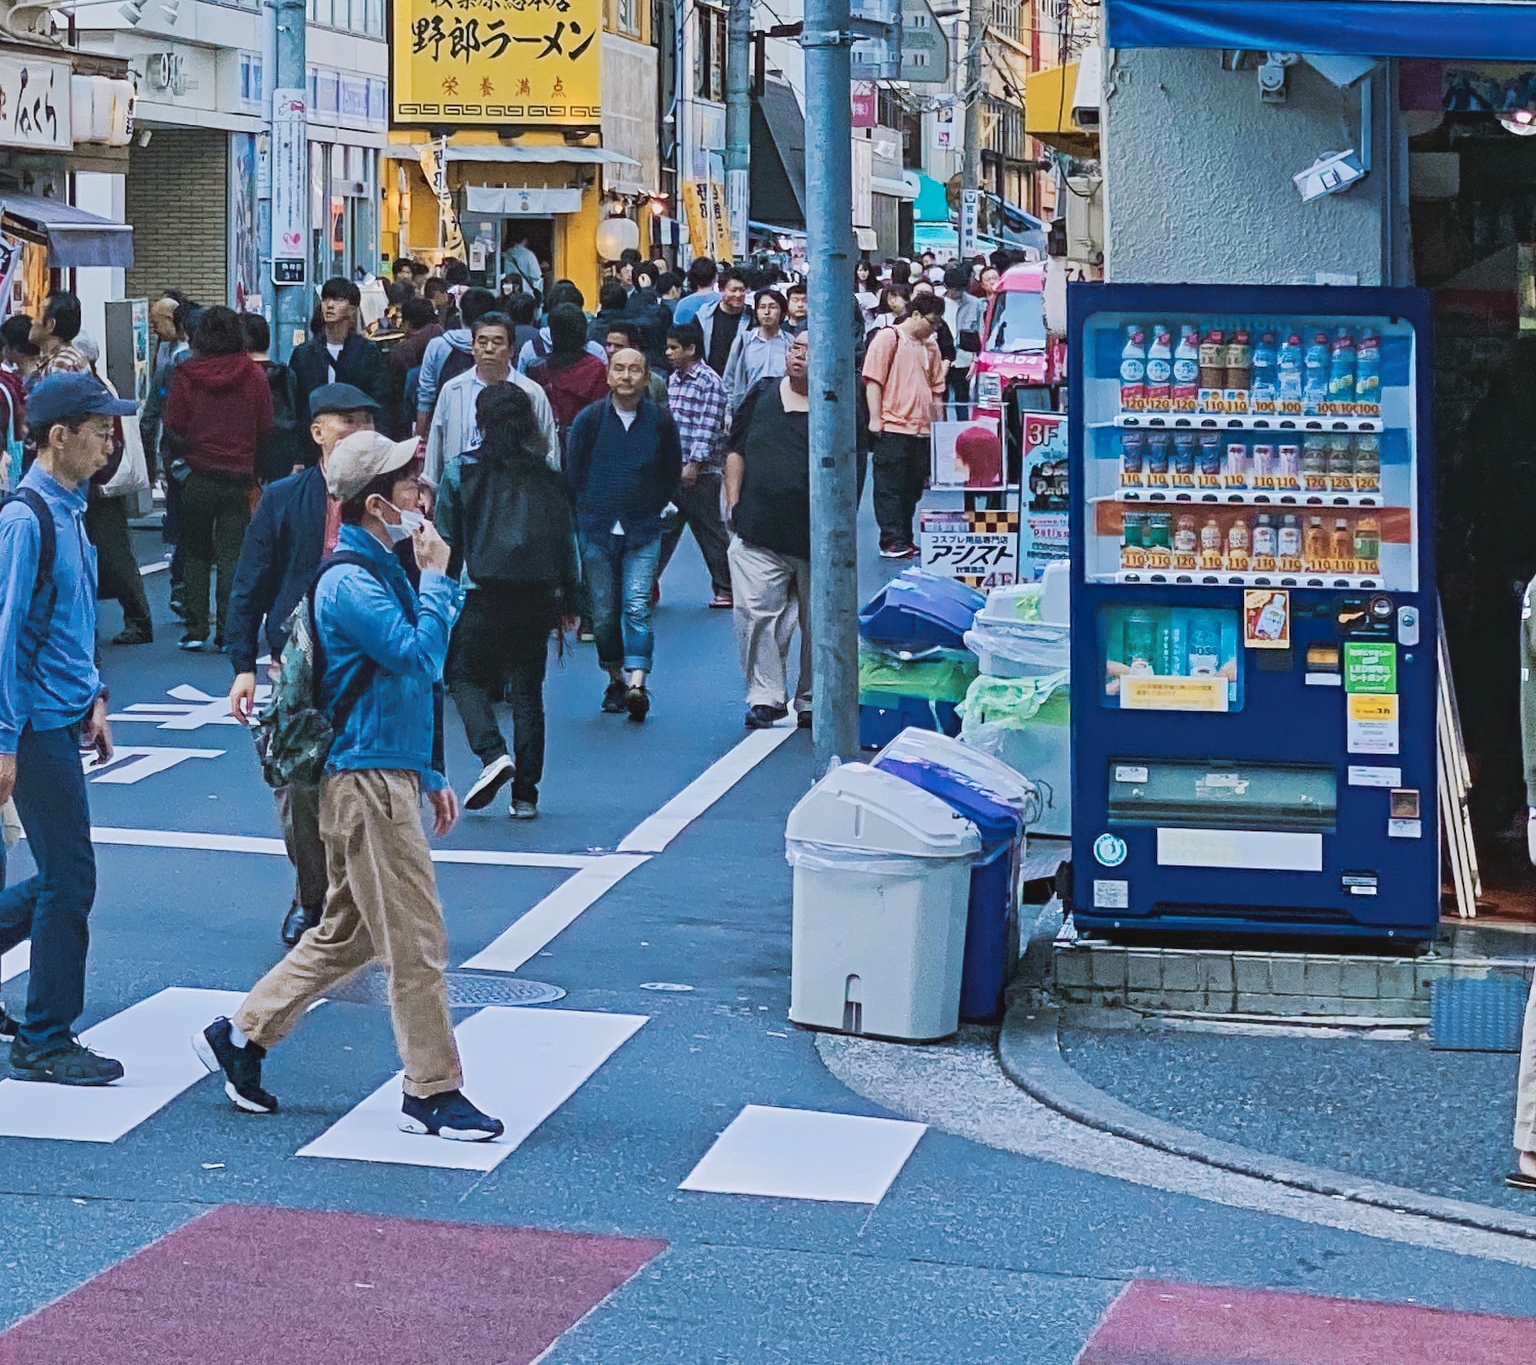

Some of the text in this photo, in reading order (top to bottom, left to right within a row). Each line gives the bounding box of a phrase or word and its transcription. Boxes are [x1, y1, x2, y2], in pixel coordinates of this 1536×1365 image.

[411, 14, 597, 65] 野郎ラーメン
[441, 75, 567, 100] 栄養満点
[1027, 422, 1059, 446] 3F
[931, 535, 1009, 544] コスプレ用品専門店
[927, 544, 1014, 565] アシスト
